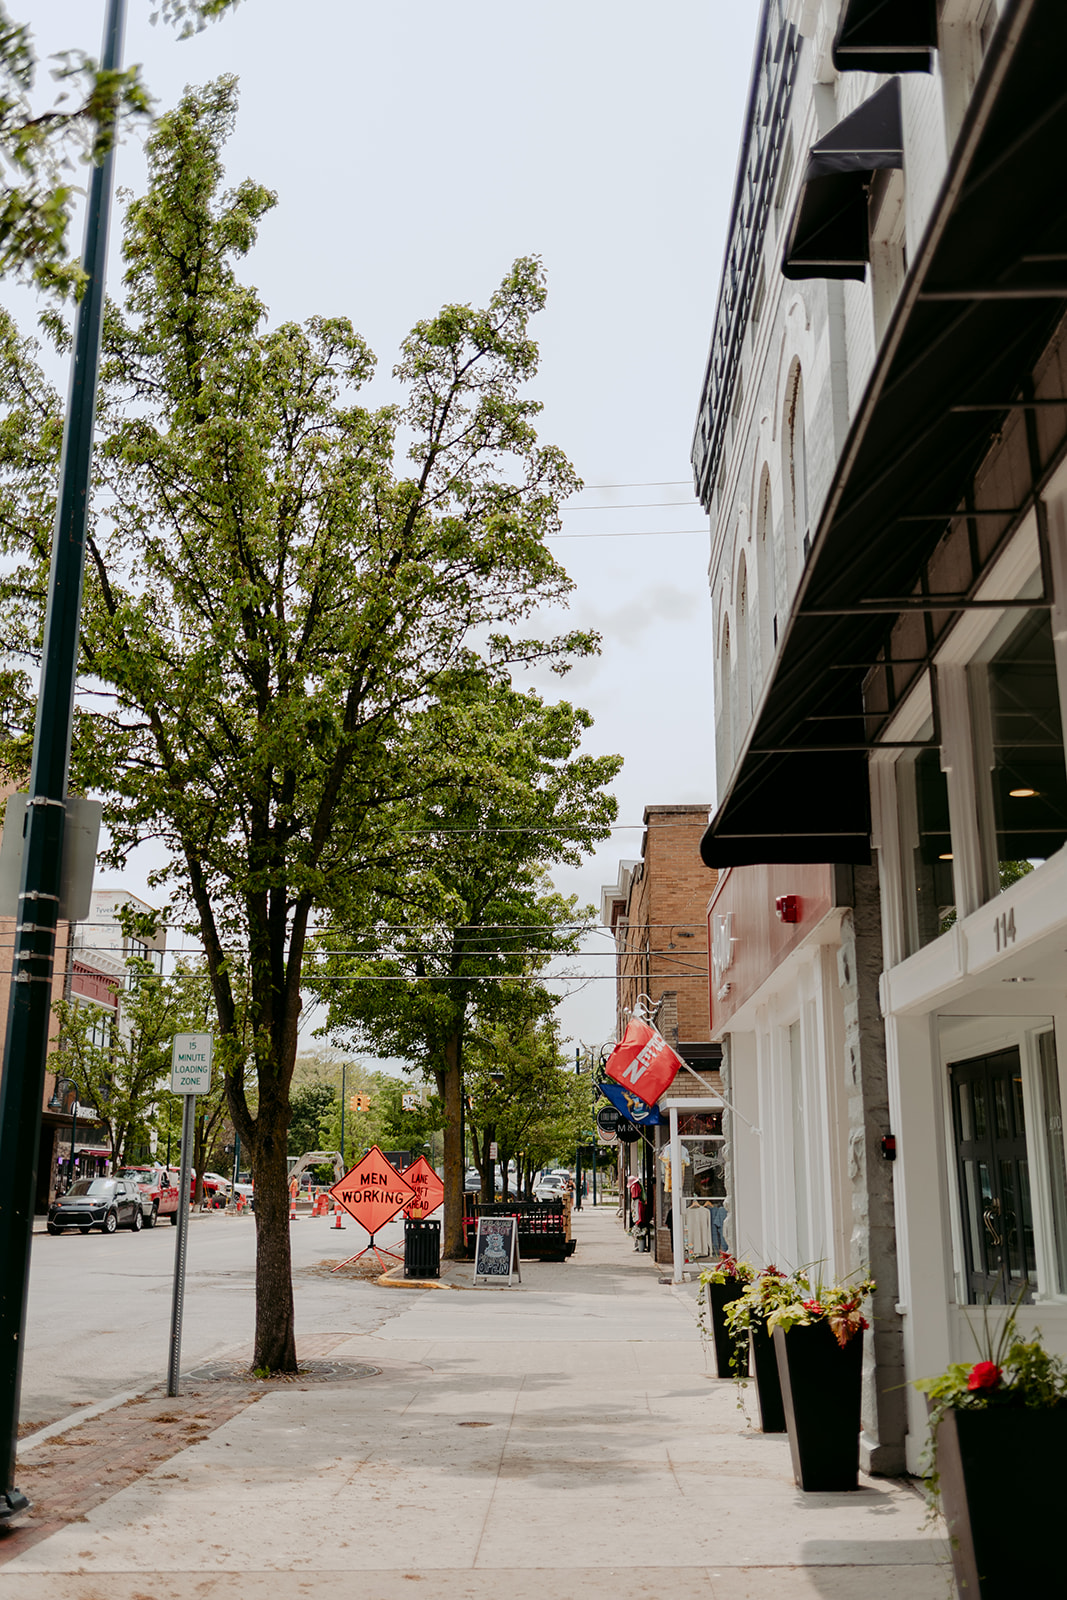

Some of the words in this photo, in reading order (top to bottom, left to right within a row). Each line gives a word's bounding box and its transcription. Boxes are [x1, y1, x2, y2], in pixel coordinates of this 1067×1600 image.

[993, 907, 1017, 953] 114
[189, 1041, 197, 1050] 15
[178, 1053, 206, 1062] MINUTE
[175, 1065, 208, 1074] LOADING
[180, 1077, 201, 1086] ZONE
[360, 1172, 388, 1186] MEN
[411, 1173, 429, 1185] LANE
[341, 1189, 404, 1205] WORKING
[477, 1261, 509, 1275] OPEN
